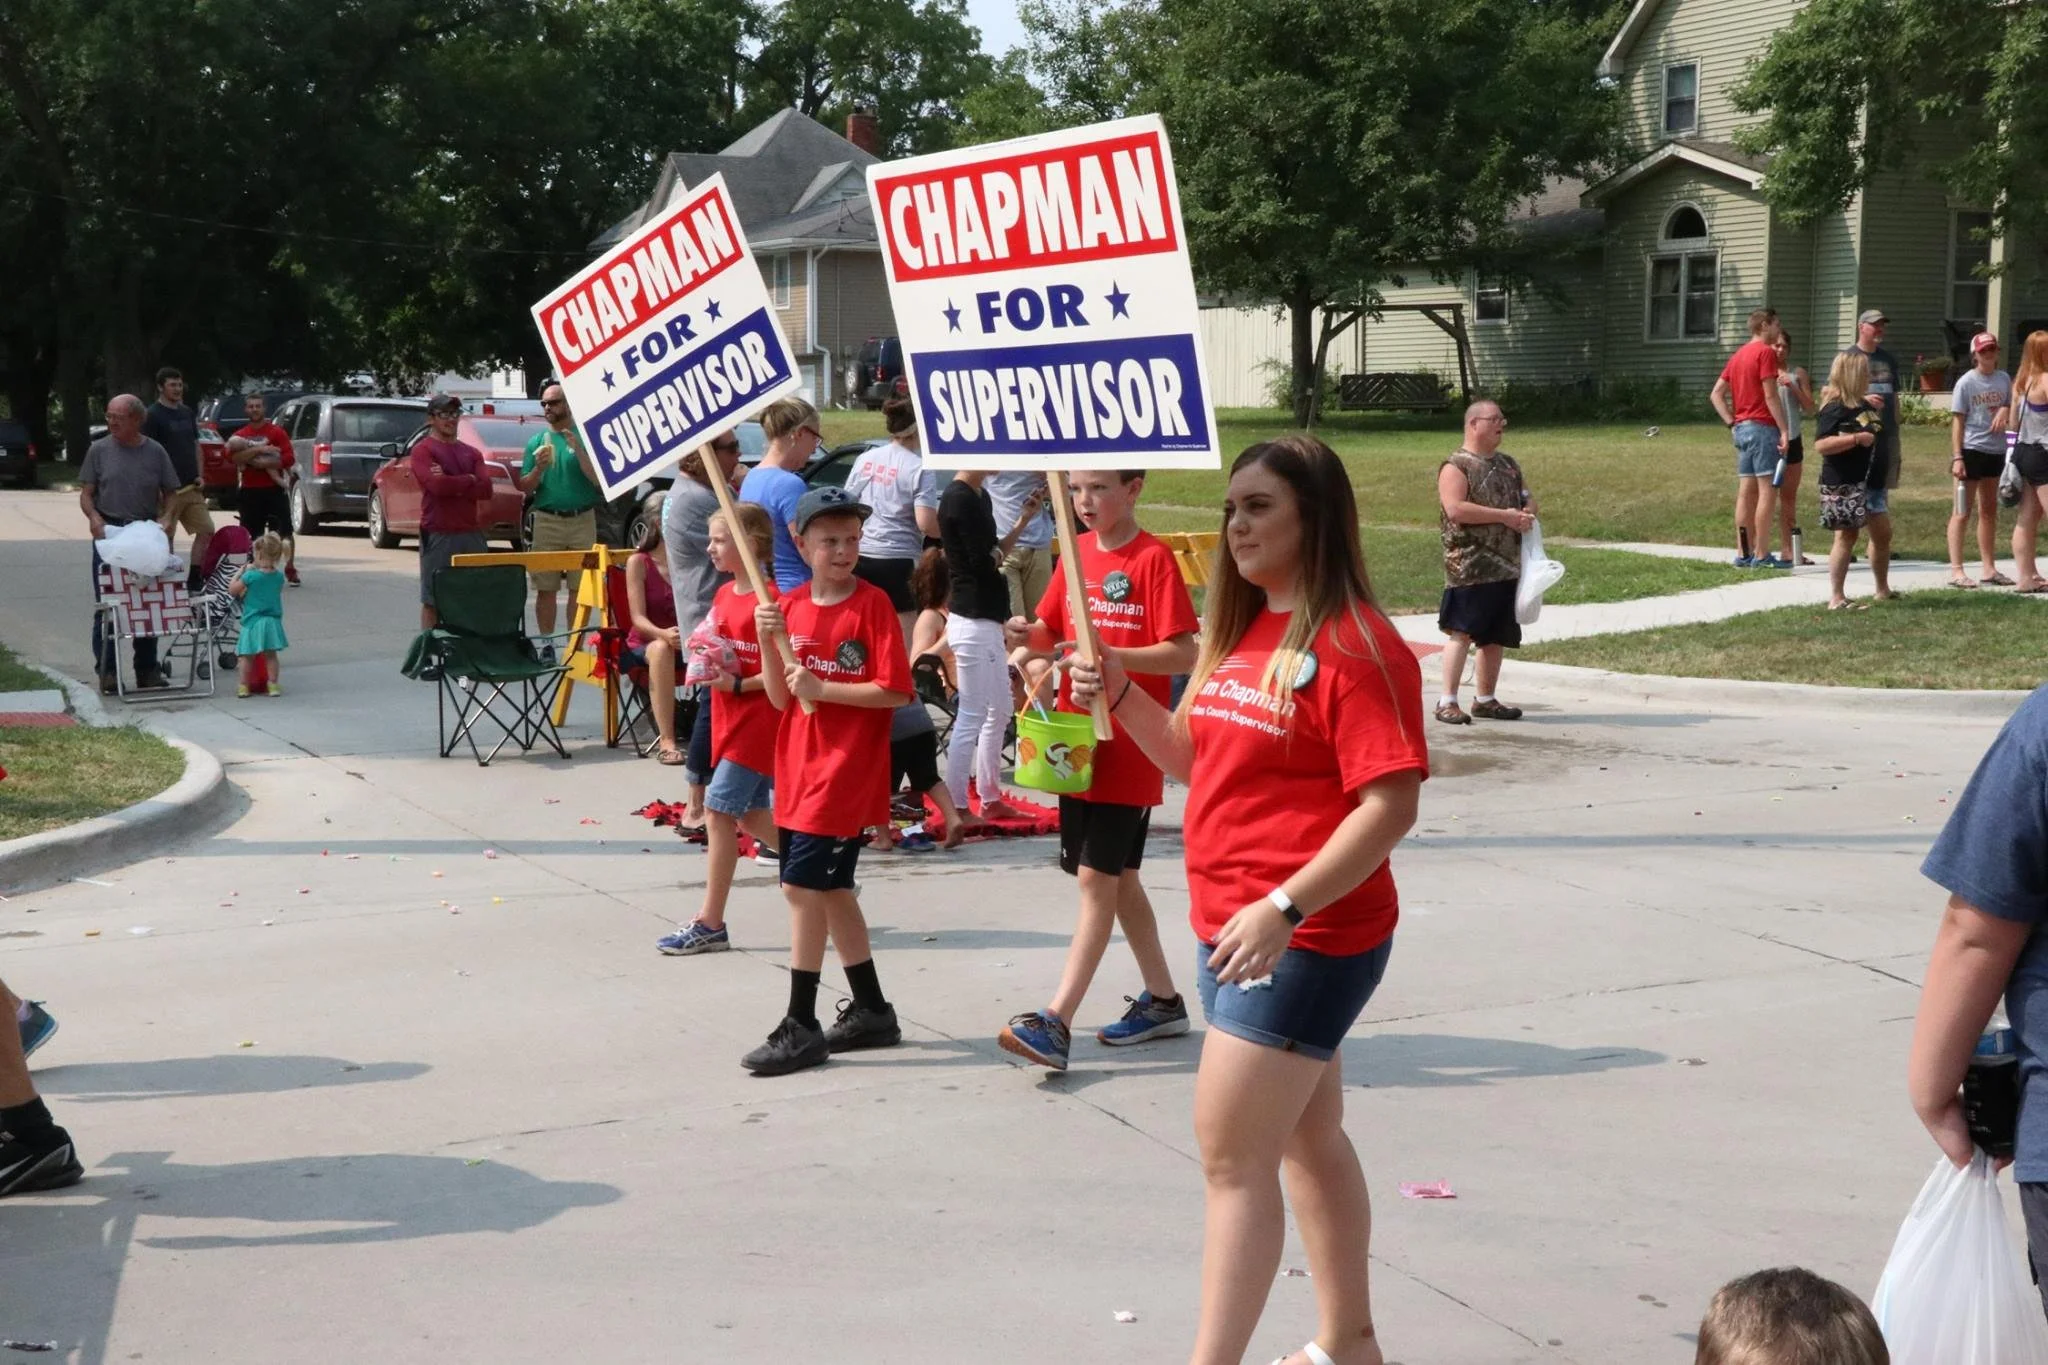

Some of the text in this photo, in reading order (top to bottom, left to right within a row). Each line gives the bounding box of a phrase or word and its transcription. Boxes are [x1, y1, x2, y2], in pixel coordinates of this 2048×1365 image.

[890, 146, 1167, 270] CHAPMAN
[551, 198, 736, 363] CHAPMAN
[976, 284, 1090, 334] FOR
[621, 313, 698, 380] FOR
[600, 331, 777, 473] SUPERVISOR
[929, 358, 1191, 442] SUPERVISOR
[1200, 678, 1296, 718] im Chapman
[1230, 710, 1287, 737] Supervisor
